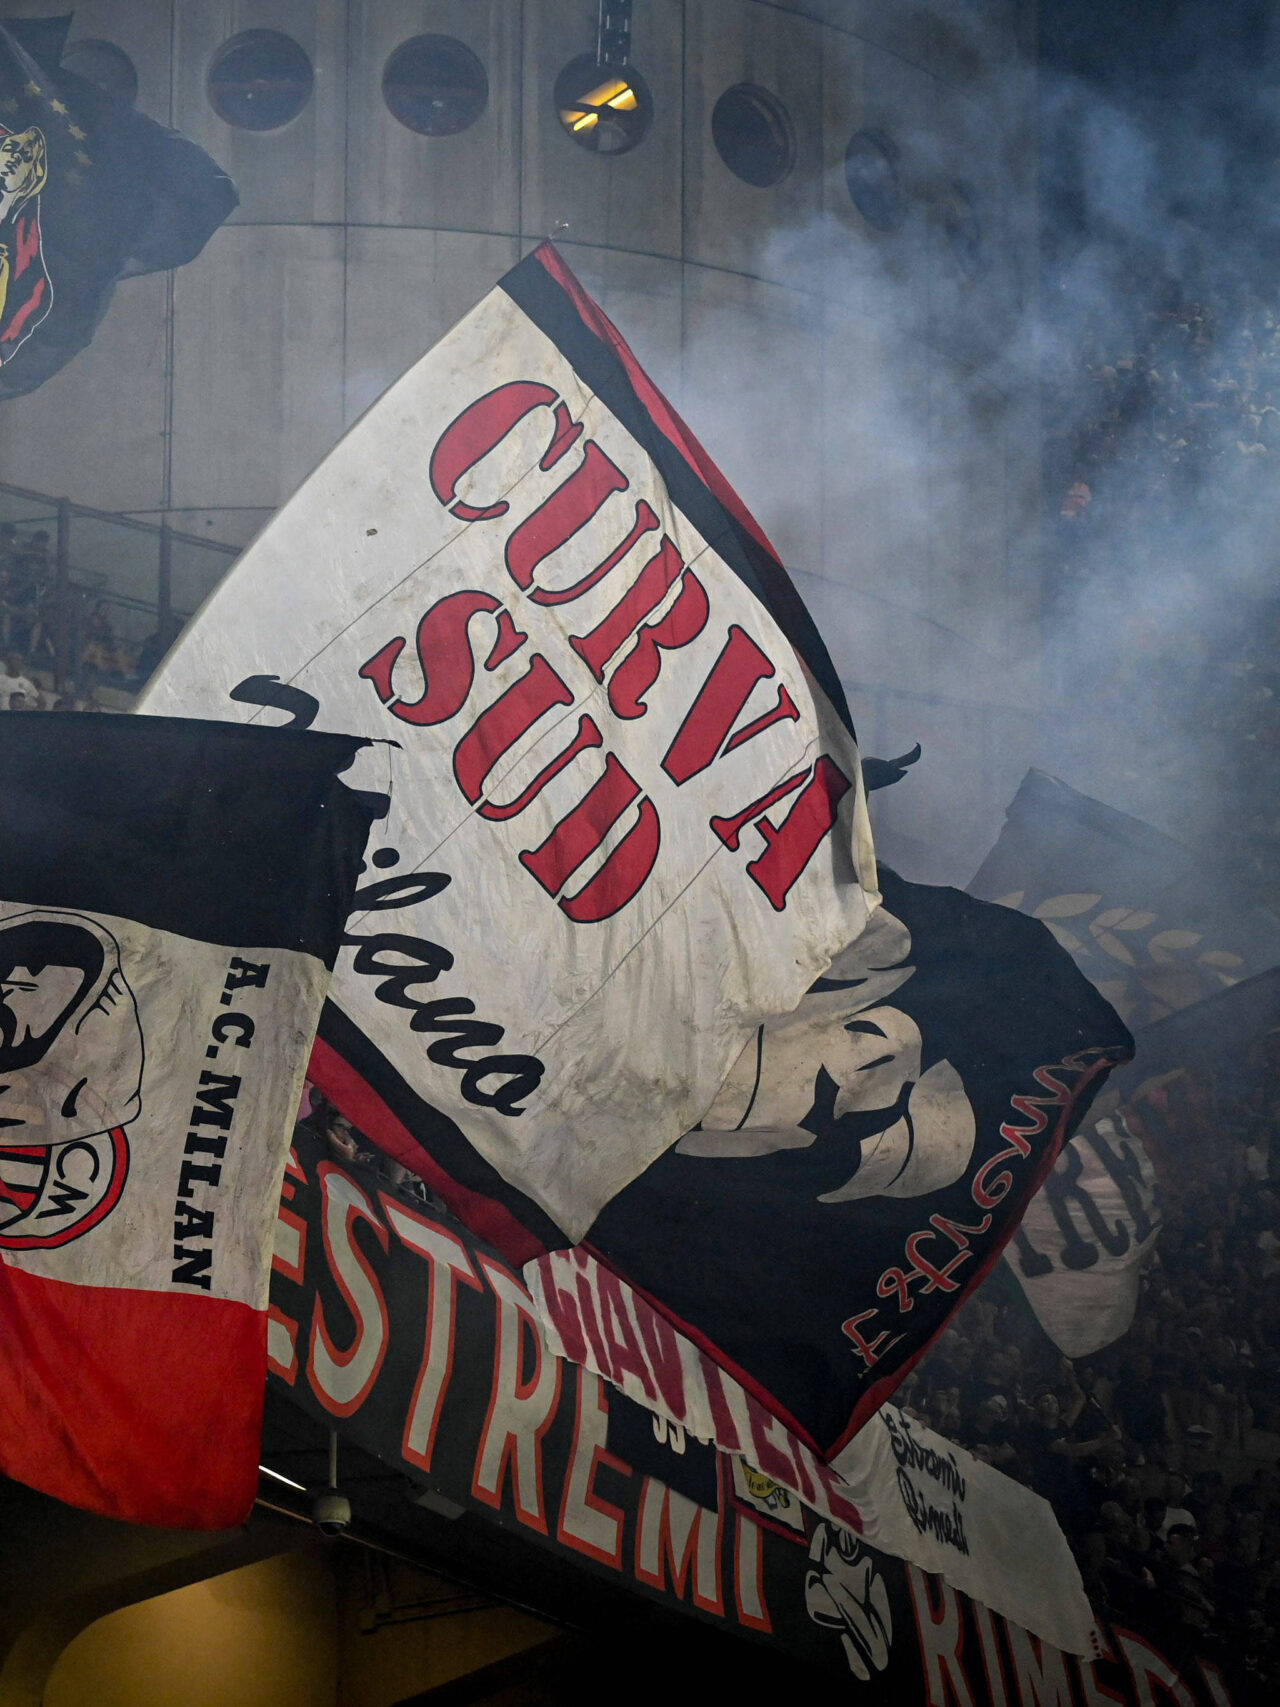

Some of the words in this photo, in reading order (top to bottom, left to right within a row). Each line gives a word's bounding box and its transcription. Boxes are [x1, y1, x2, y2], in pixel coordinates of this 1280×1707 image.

[359, 589, 661, 923] SUD
[429, 380, 852, 912] CURVA
[206, 957, 270, 1059] A.C.
[172, 1070, 241, 1290] MILAN
